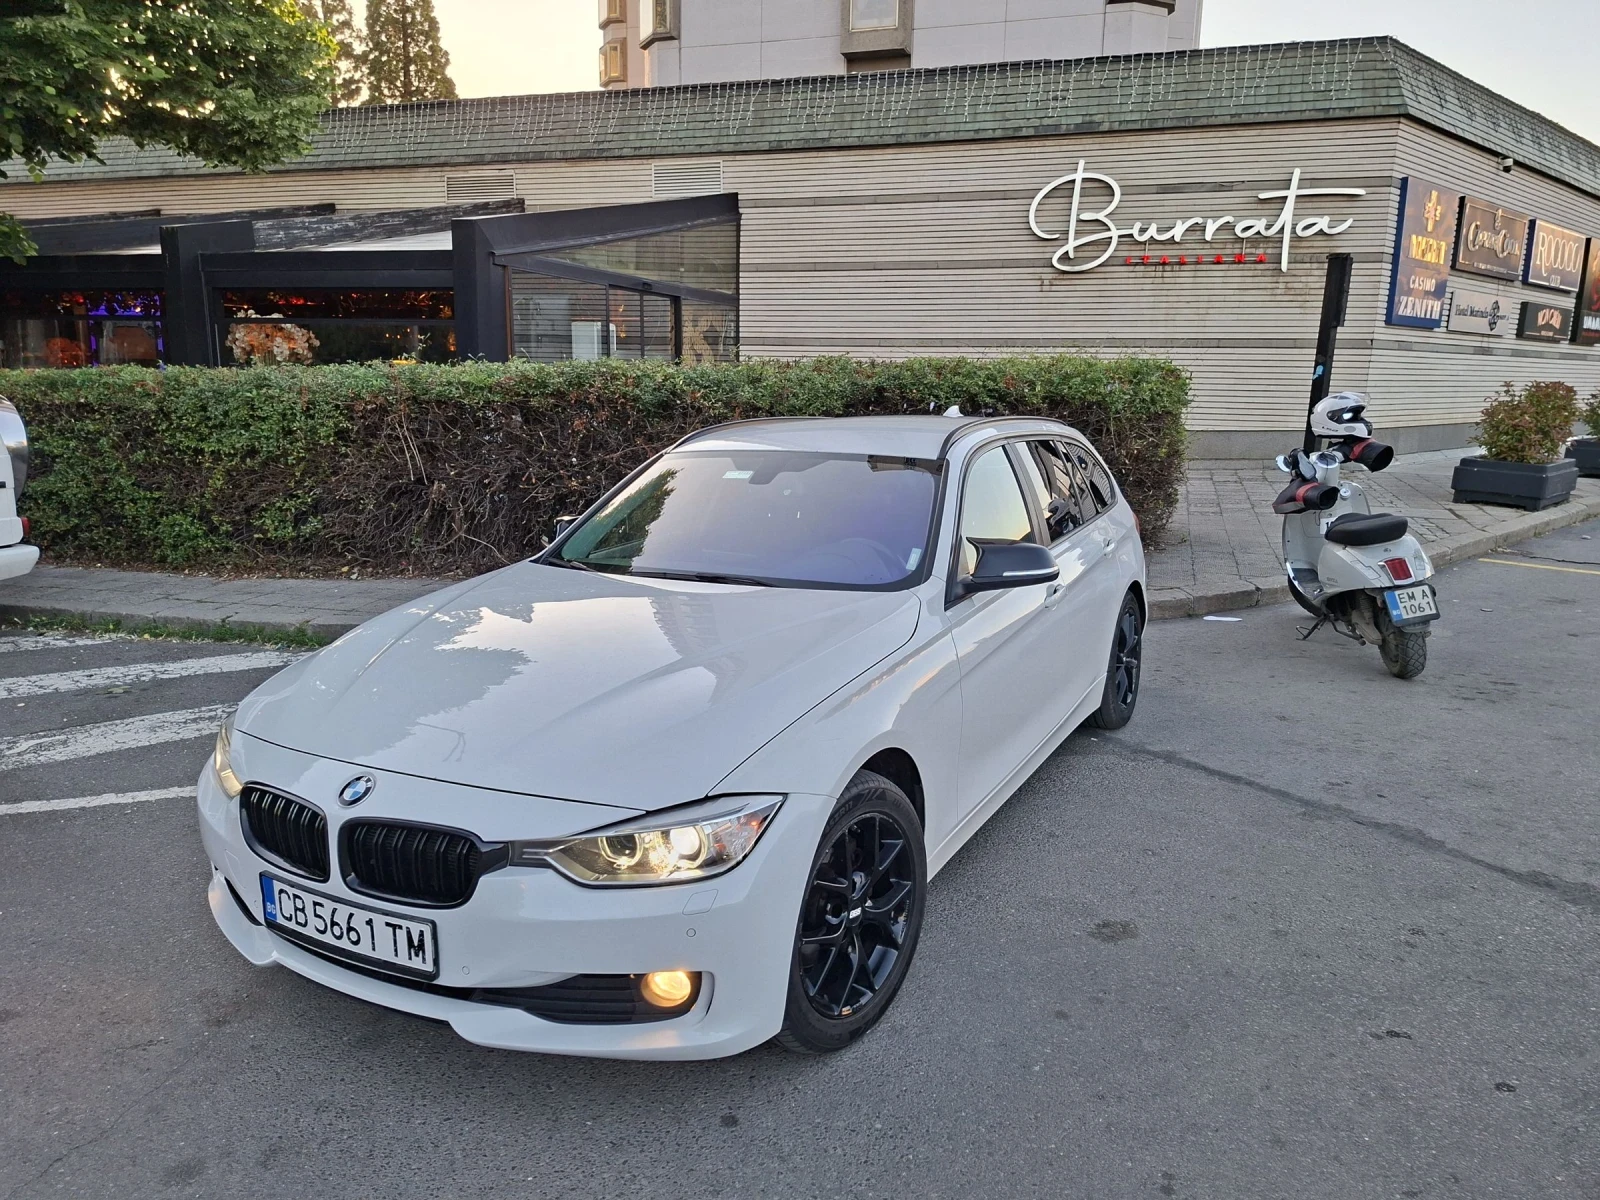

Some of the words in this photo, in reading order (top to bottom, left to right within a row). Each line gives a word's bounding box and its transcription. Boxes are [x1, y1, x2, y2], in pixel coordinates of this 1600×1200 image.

[1029, 159, 1367, 272] Burrata
[1125, 253, 1267, 265] ITALIANA
[1409, 275, 1436, 292] CASINO
[1397, 295, 1441, 320] ZENITH
[1397, 591, 1417, 604] EM
[1421, 588, 1430, 600] A
[1402, 600, 1433, 616] 1061
[266, 902, 276, 914] BG
[278, 888, 308, 928] CB
[312, 899, 376, 952] 5661
[385, 921, 427, 965] TM
